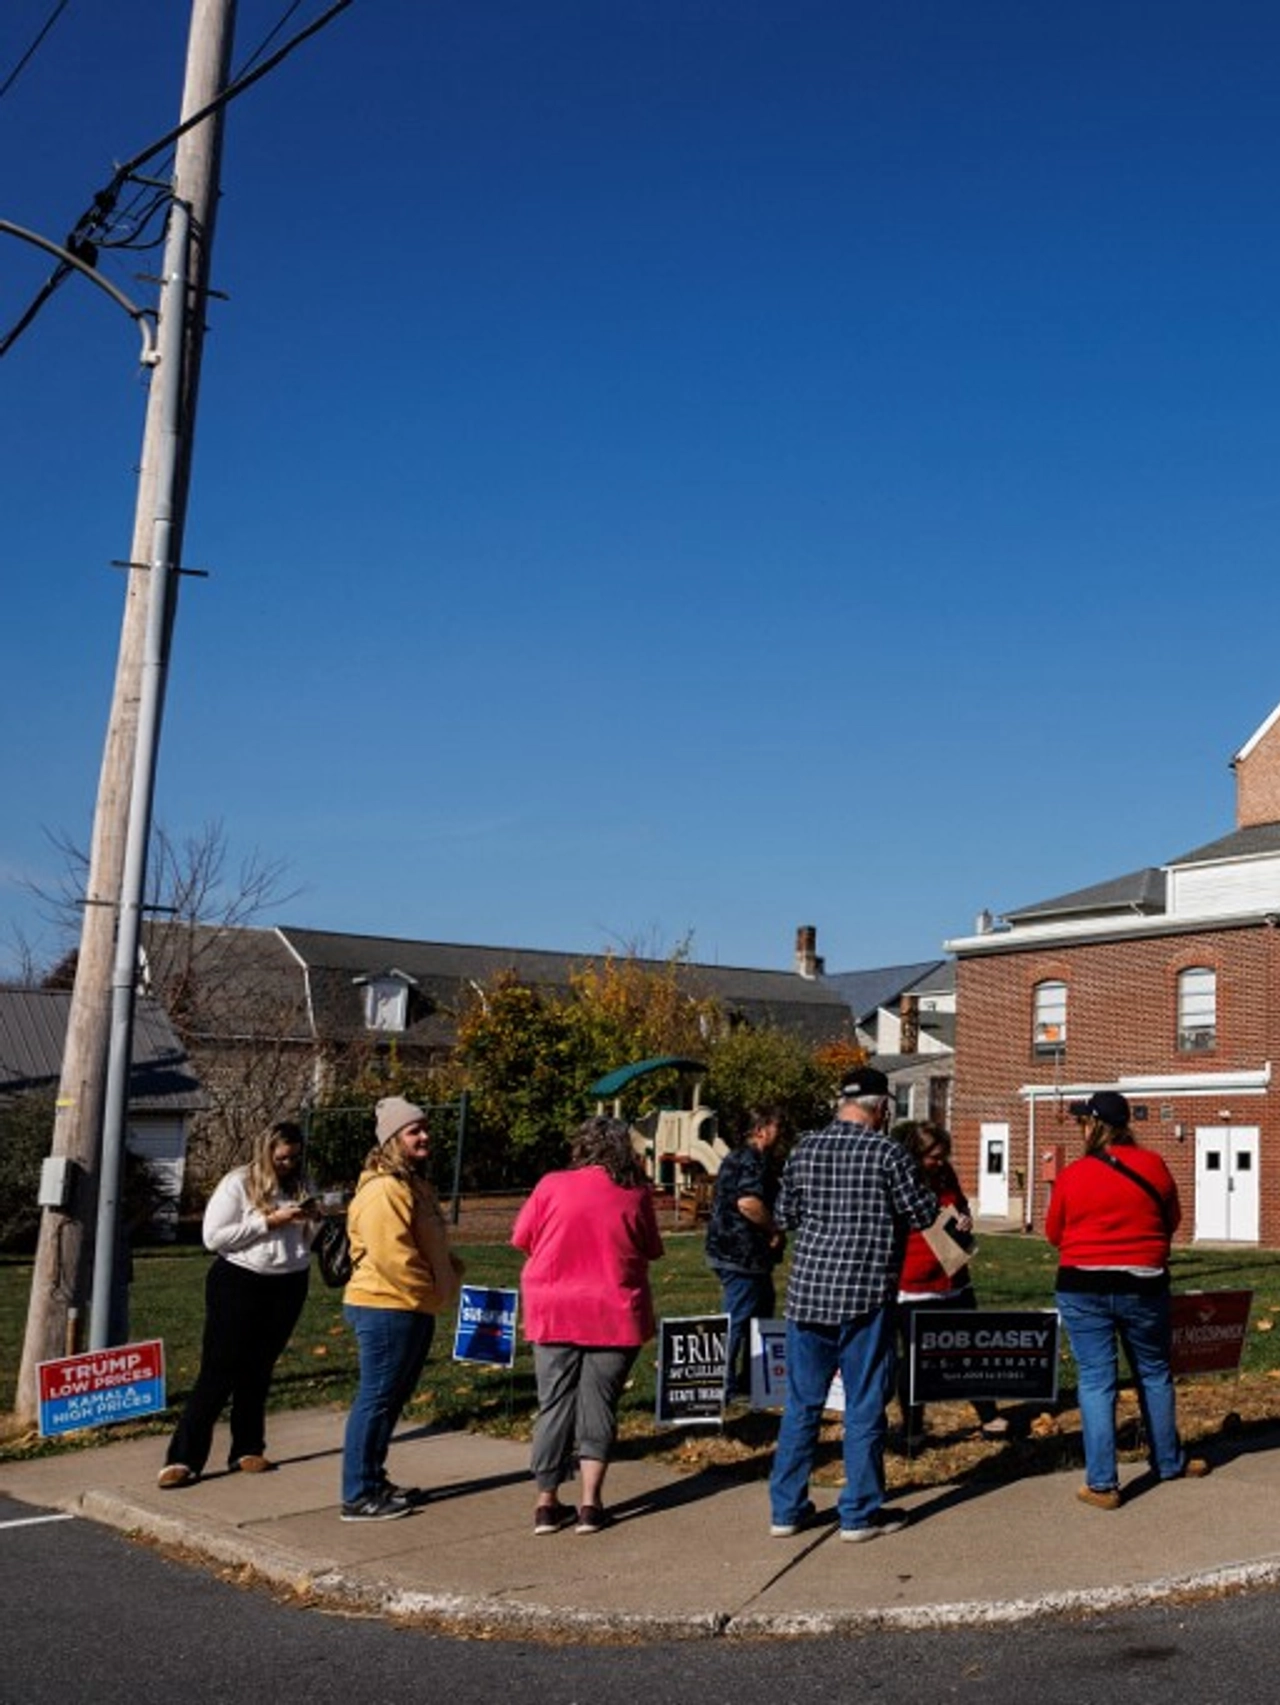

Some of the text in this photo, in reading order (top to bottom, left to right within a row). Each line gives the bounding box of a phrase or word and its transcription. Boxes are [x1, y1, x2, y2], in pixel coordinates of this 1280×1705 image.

[670, 1332, 727, 1364] ERIN
[921, 1330, 1048, 1349] BOB CASEY
[61, 1354, 142, 1381] TRUMP
[981, 1357, 1048, 1368] SENATE
[49, 1367, 153, 1399] LOW PRICES
[52, 1393, 152, 1424] HIGH PRICES
[67, 1386, 137, 1410] KAMALA
